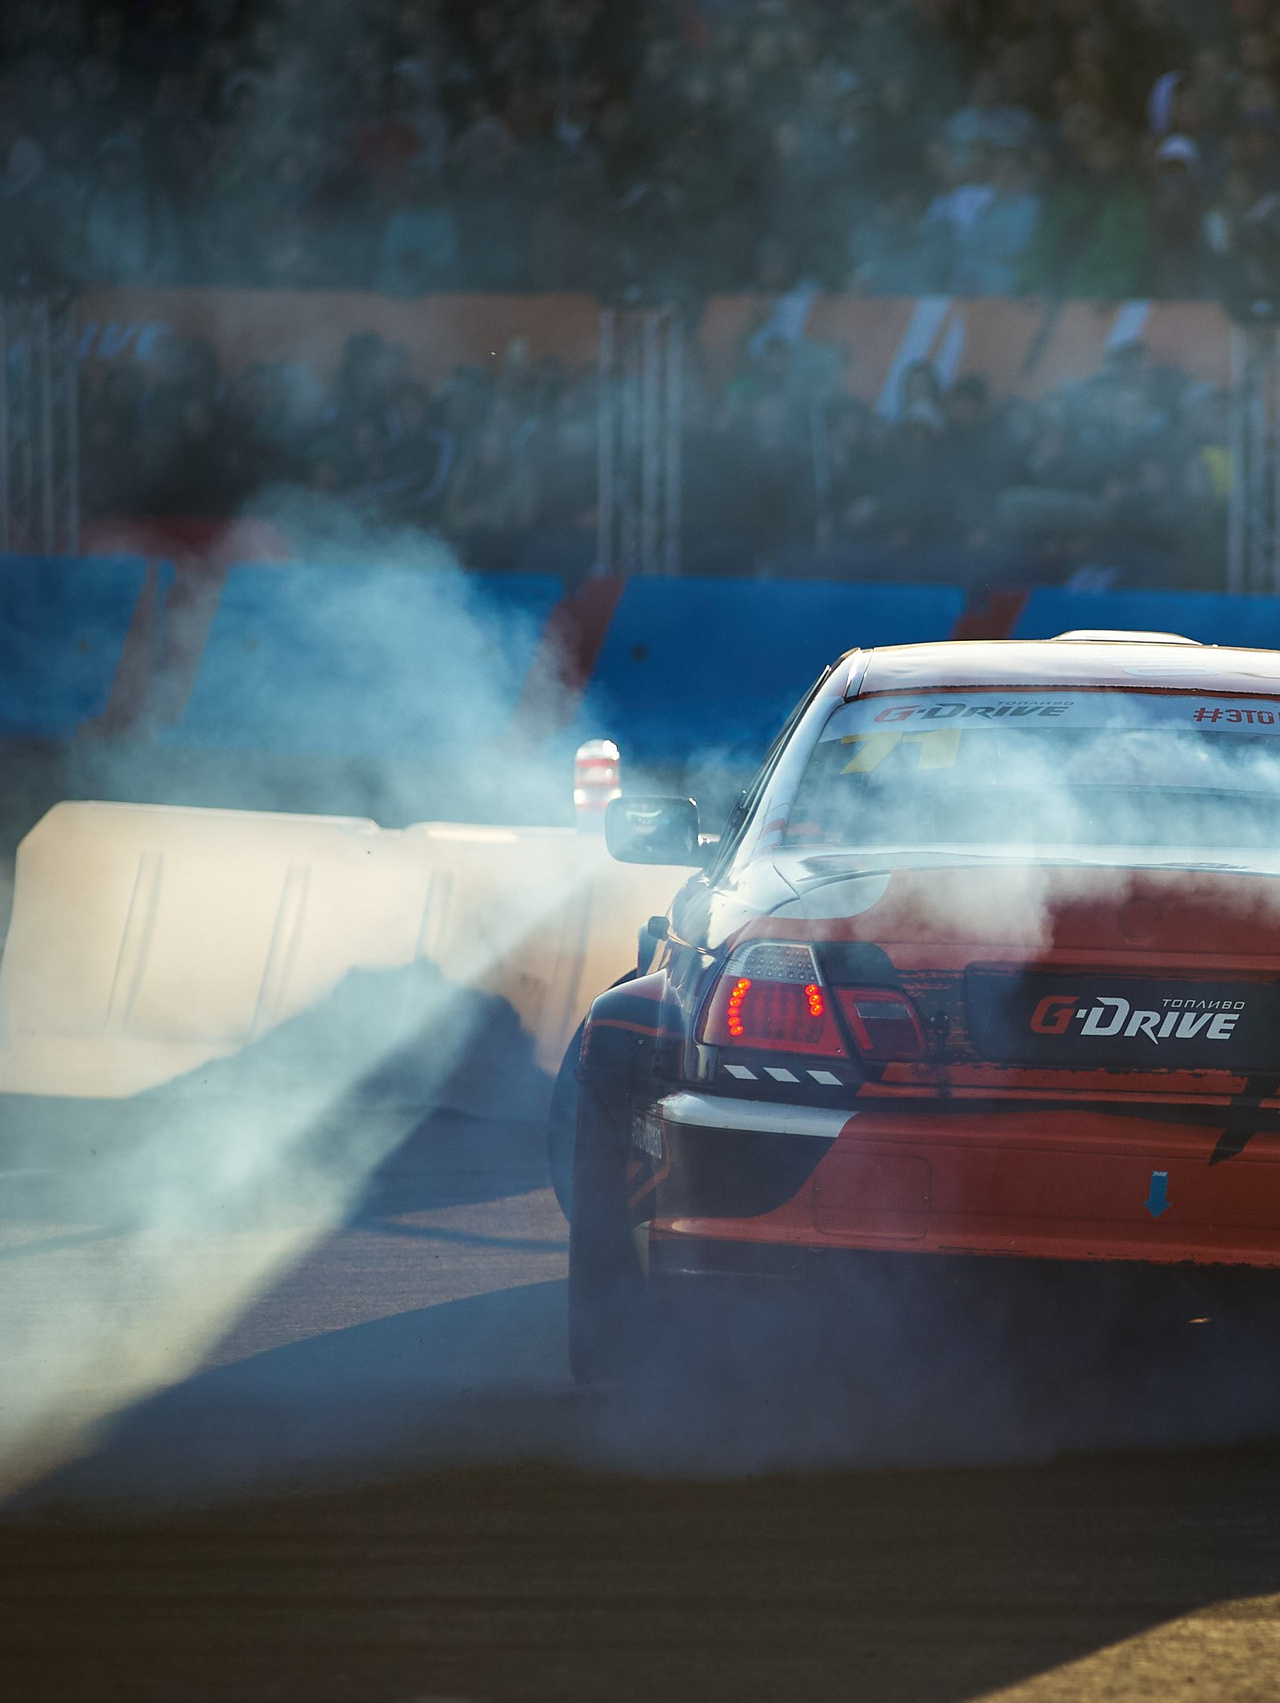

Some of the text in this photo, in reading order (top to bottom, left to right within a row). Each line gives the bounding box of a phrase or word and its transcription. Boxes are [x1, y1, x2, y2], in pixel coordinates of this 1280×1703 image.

[840, 728, 962, 775] 71
[1030, 995, 1240, 1045] G-DRIVE
[1162, 998, 1246, 1010] ТОПЛИВО
